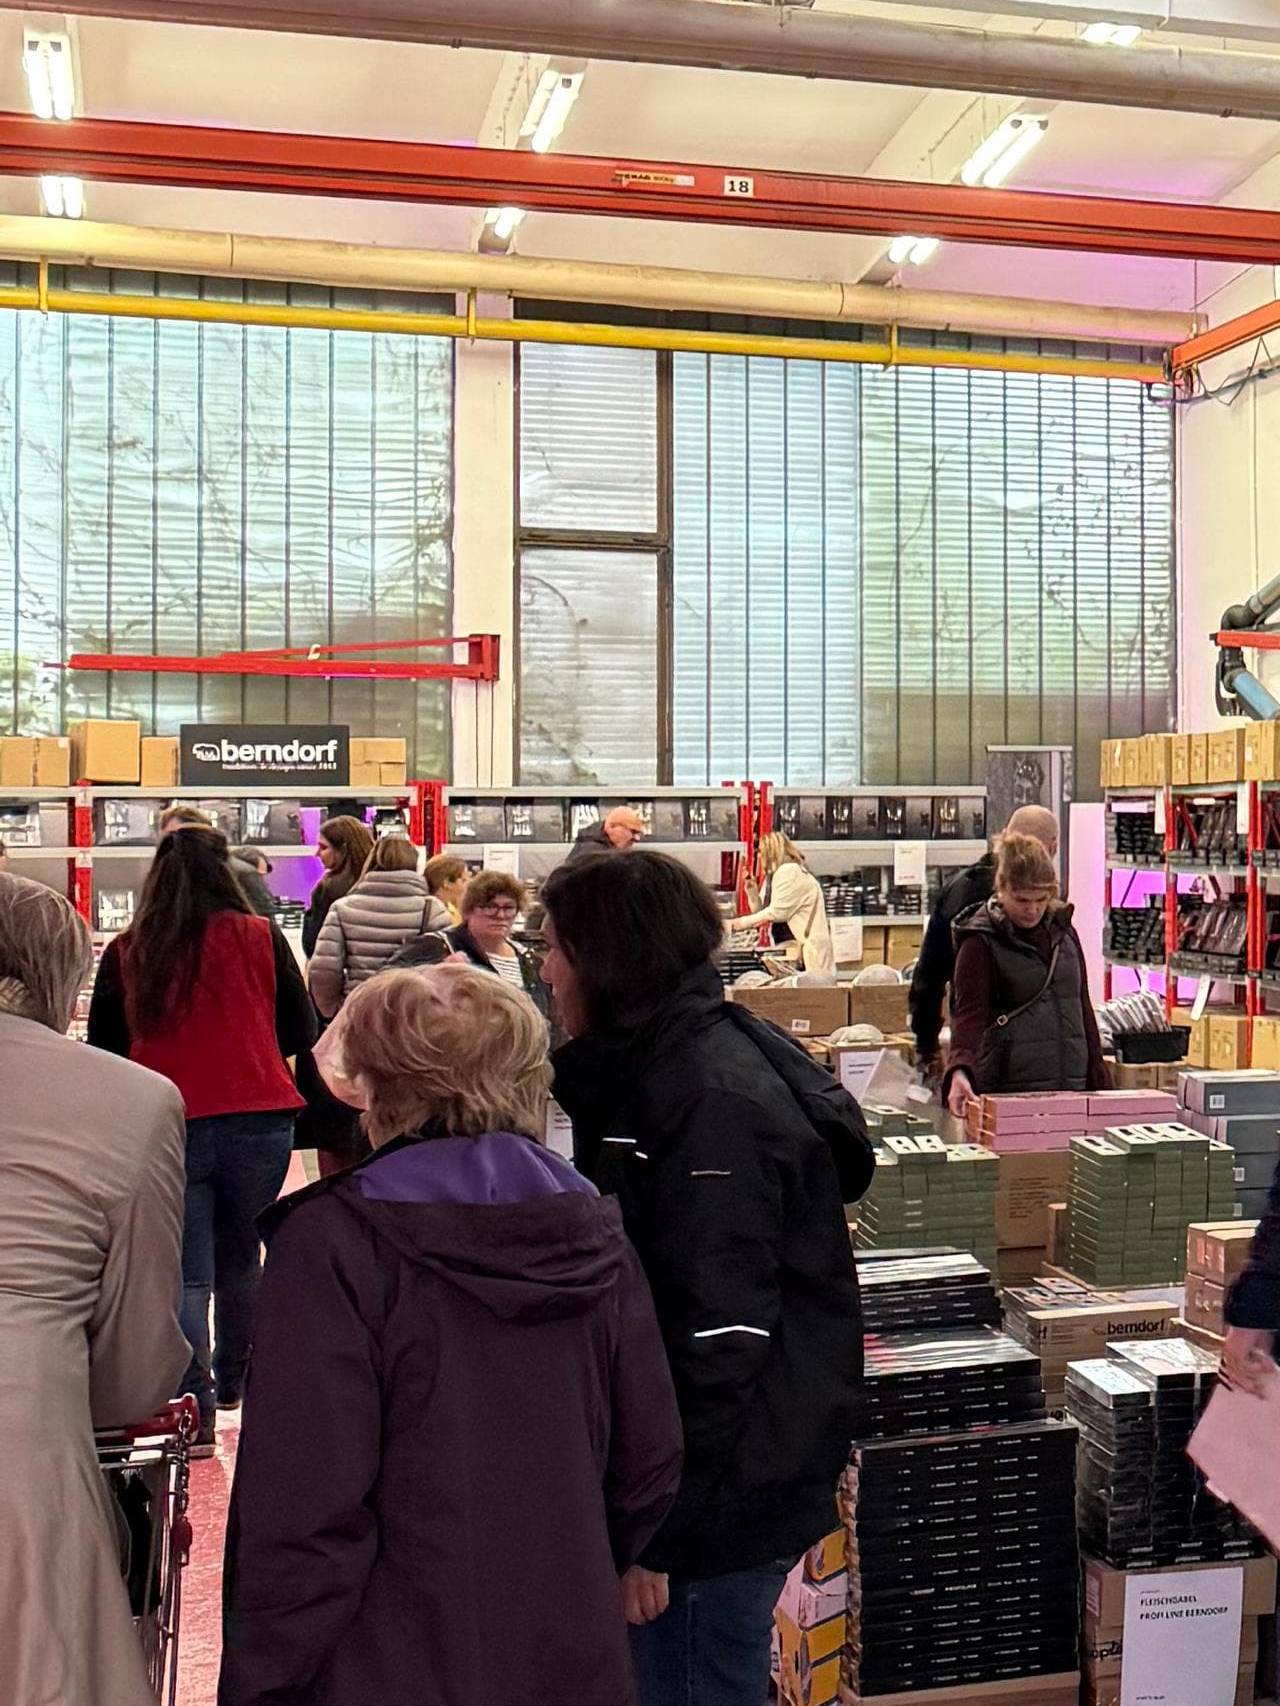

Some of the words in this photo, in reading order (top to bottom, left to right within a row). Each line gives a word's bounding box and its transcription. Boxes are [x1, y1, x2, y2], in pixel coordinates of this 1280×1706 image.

[728, 179, 750, 194] 18
[221, 739, 338, 762] berndorf
[1107, 1318, 1167, 1335] berndorf
